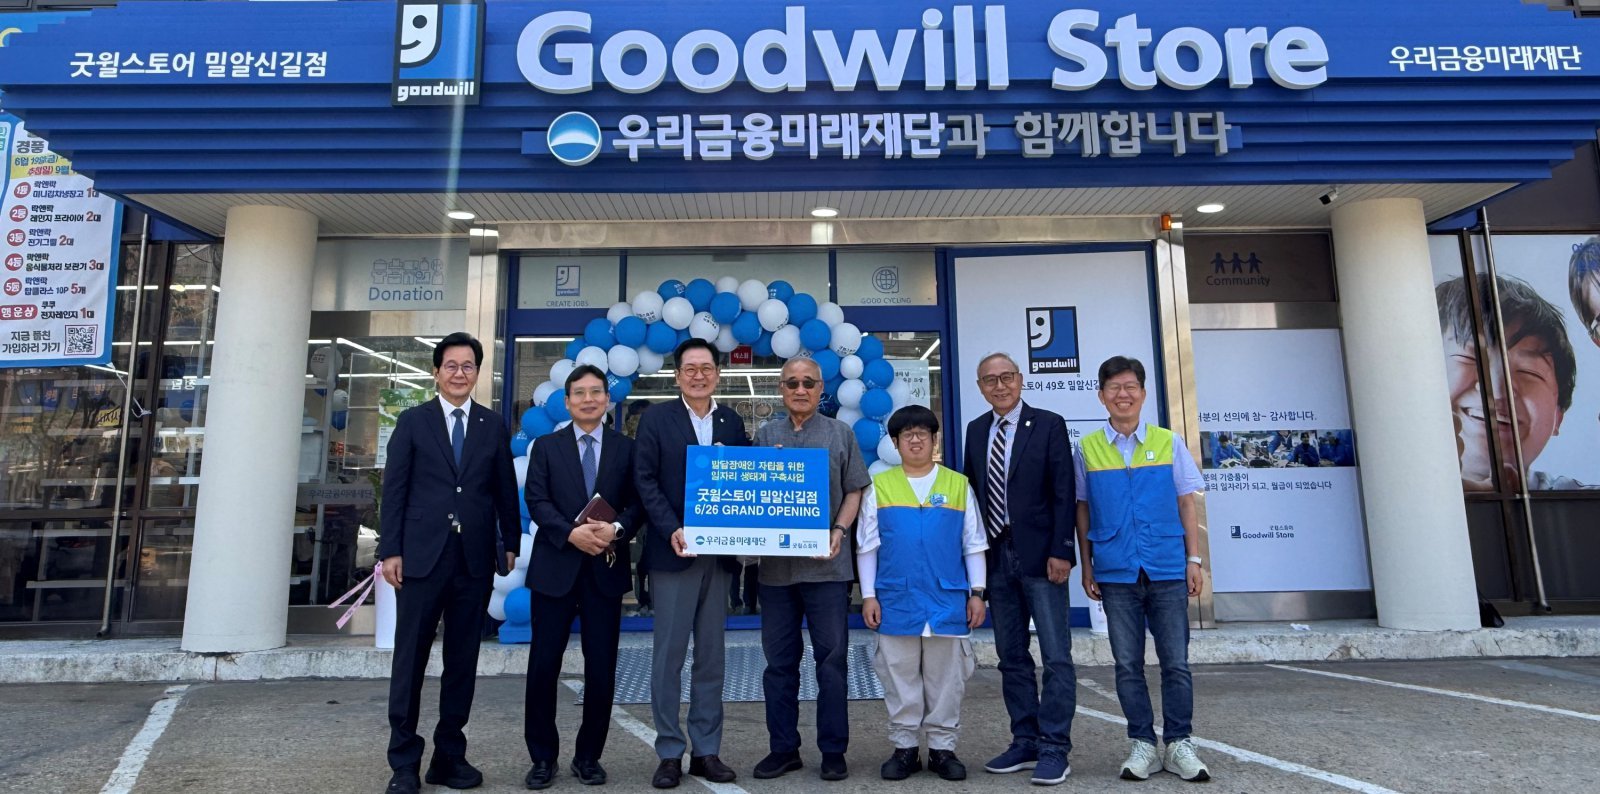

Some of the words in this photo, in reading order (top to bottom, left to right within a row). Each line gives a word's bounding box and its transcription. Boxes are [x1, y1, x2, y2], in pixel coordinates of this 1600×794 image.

[516, 5, 1009, 94] Goodwill
[1048, 8, 1329, 91] Store
[69, 51, 195, 78] 굿윌스토어
[205, 51, 328, 77] 밀알신길점
[1389, 46, 1582, 72] 우리금융미래재단
[397, 81, 475, 102] goodwill
[612, 112, 991, 162] 우리금융미래재단과
[1014, 111, 1232, 158] 함께합니다
[16, 140, 44, 154] 경품
[12, 208, 27, 218] 2등
[54, 214, 84, 222] 프라이어
[86, 211, 102, 223] 2대
[59, 235, 74, 247] 2대
[64, 262, 87, 271] 보관기
[89, 259, 105, 271] 3대
[1205, 275, 1271, 287] Community
[71, 283, 87, 295] 5개
[368, 286, 444, 301] Donation
[41, 310, 78, 319] 전자레인지
[80, 307, 95, 318] 1대
[10, 331, 30, 342] 지금
[2, 343, 39, 354] 가입하러
[41, 342, 60, 353] 가기
[1032, 358, 1077, 372] goodwill
[1045, 380, 1065, 390] 49호
[1223, 411, 1250, 422] 선의에
[1269, 410, 1317, 422] 감사합니다.
[711, 460, 755, 471] 발달장애인
[758, 461, 785, 471] 자립을
[787, 461, 805, 472] 위한
[711, 471, 737, 482] 일자리
[740, 472, 767, 482] 생태계
[769, 473, 805, 483] 구축사업
[1219, 472, 1249, 482] 기증품이
[1220, 482, 1250, 491] 일자리가
[1271, 482, 1293, 491] 월급이
[1295, 481, 1332, 491] 되었습니다
[697, 488, 756, 503] 굿윌스토어
[760, 490, 818, 505] 밀알신길점
[694, 504, 719, 516] 6/26
[722, 505, 764, 516] GRAND
[767, 506, 820, 517] OPENING
[705, 535, 767, 547] 우리금융미래재단
[1242, 531, 1275, 539] Goodwill
[1275, 531, 1295, 539] Store
